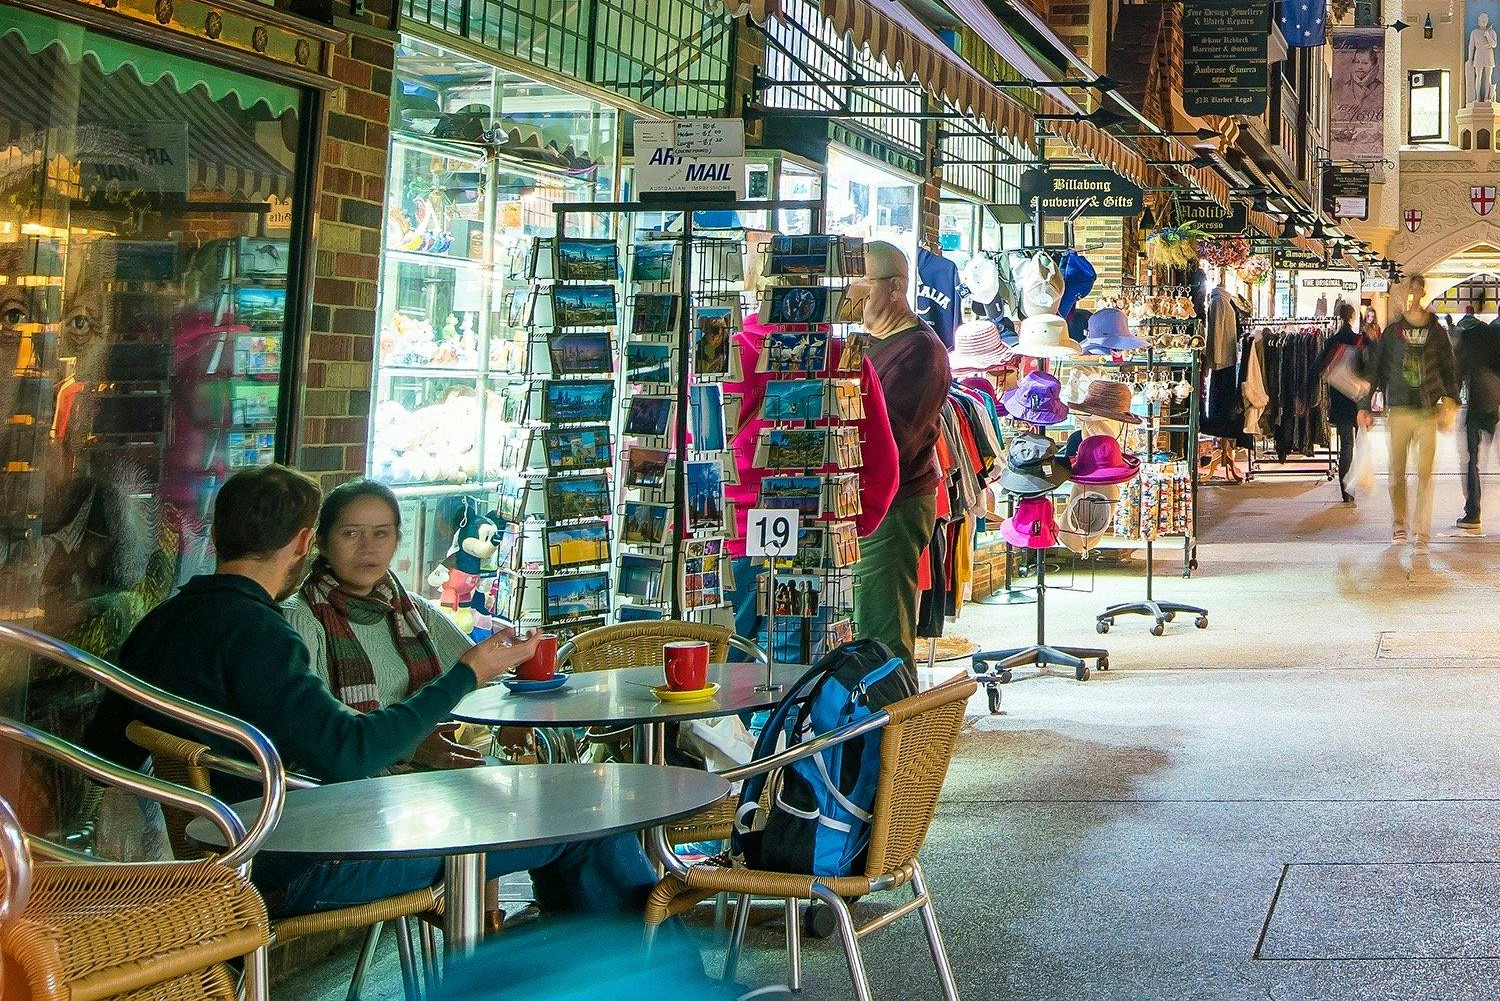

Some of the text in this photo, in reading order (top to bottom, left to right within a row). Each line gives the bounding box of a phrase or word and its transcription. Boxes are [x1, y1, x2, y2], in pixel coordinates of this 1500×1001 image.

[685, 163, 732, 182] MAIL
[1053, 178, 1111, 192] Billabong
[1103, 196, 1133, 208] Gifts
[1303, 279, 1315, 287] THE
[1315, 279, 1342, 287] ORIGINAL
[755, 516, 790, 548] 19
